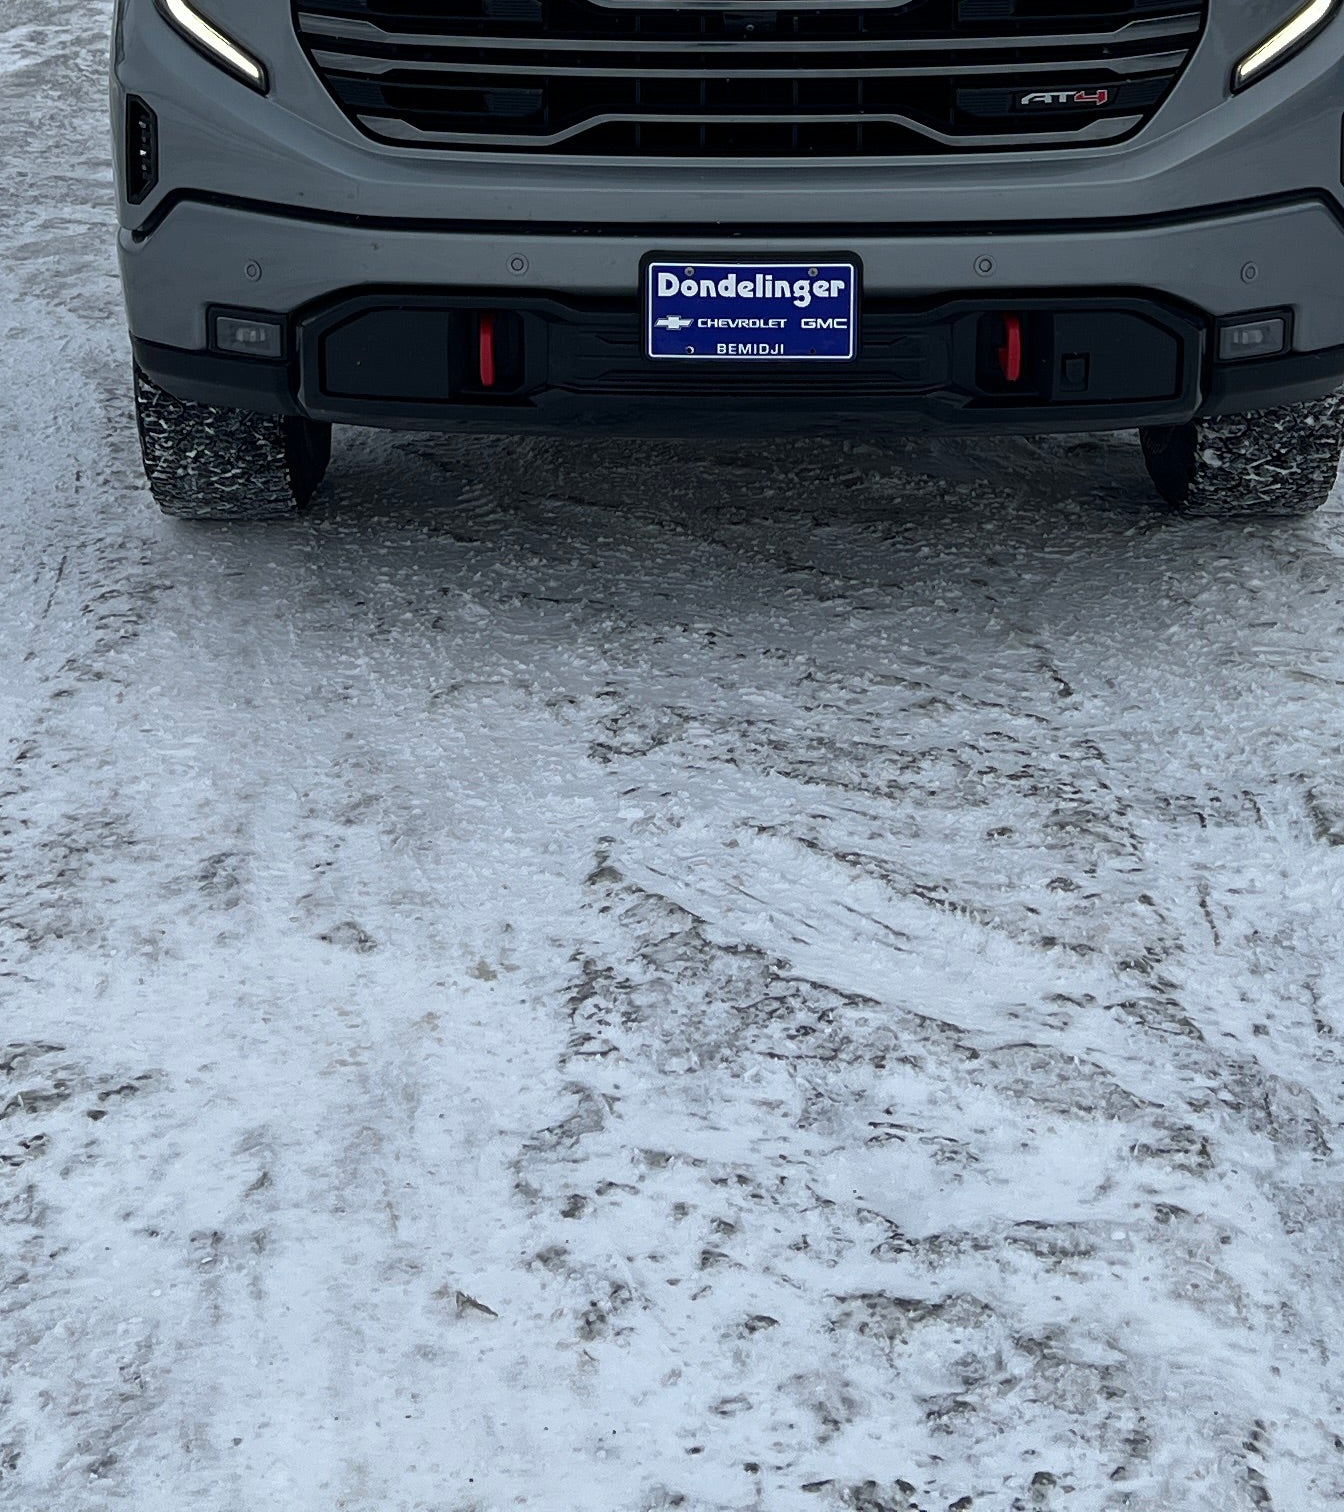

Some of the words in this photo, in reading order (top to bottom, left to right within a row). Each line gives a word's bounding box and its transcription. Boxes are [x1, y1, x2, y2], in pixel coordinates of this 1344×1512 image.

[1021, 89, 1108, 105] AT4
[658, 272, 845, 307] Dondelinger
[698, 318, 787, 329] CHEVROLET
[801, 318, 848, 329] GMC
[716, 343, 784, 355] BEMIDJI
